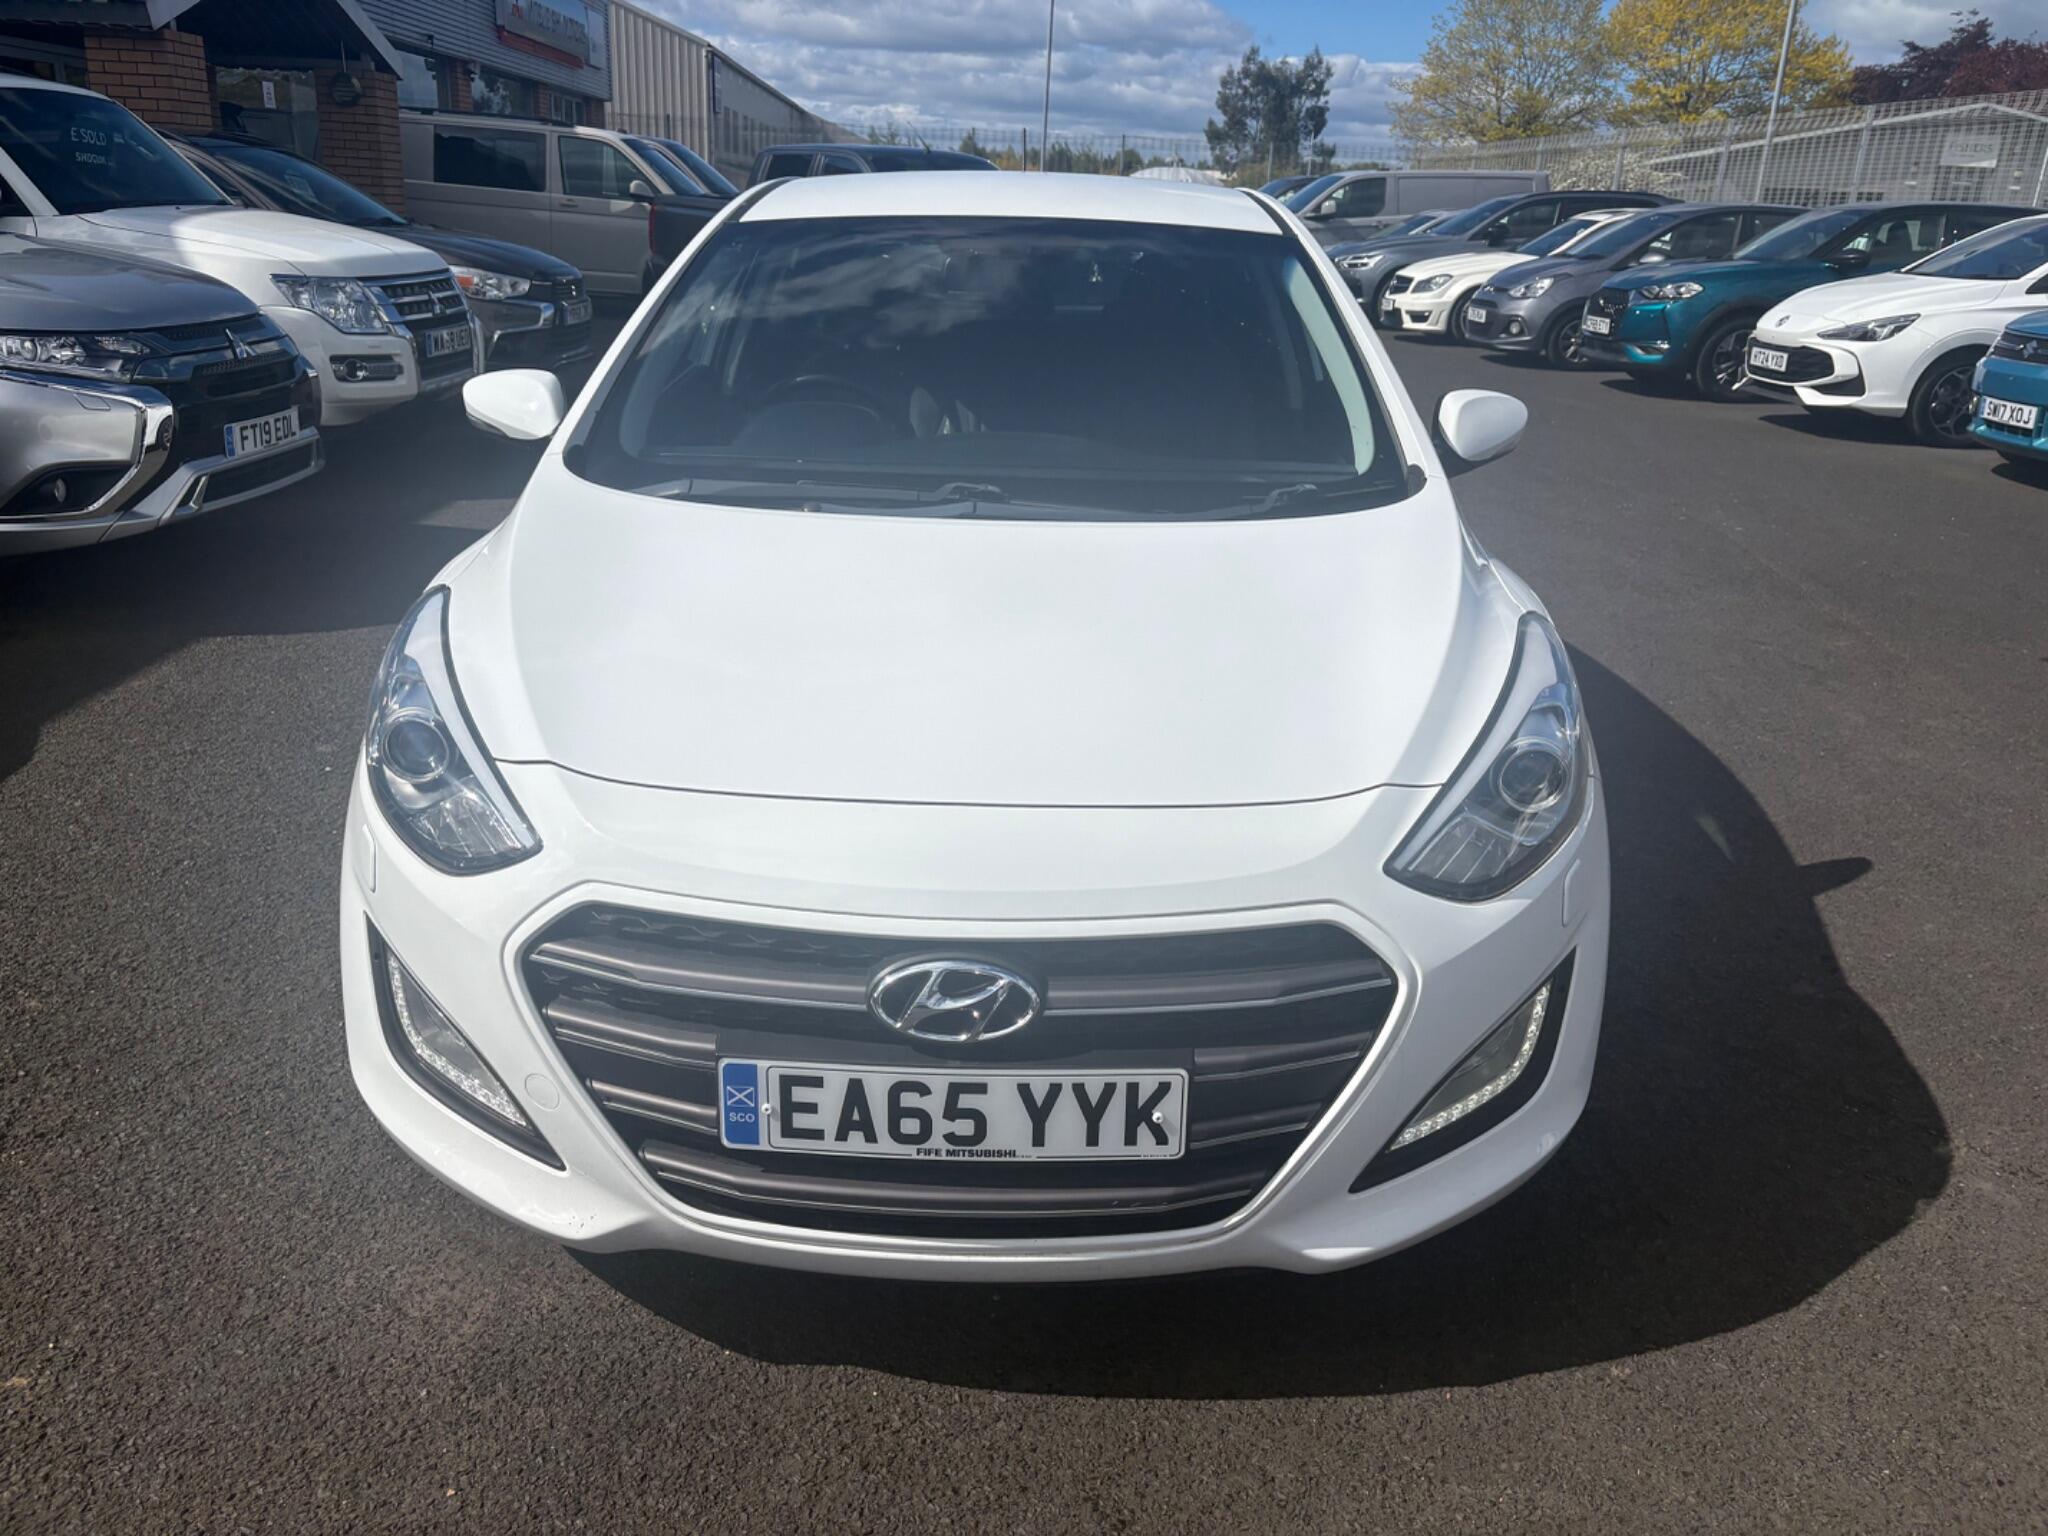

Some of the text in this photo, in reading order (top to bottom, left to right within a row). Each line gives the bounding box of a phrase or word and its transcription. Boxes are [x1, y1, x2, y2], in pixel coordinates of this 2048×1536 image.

[2008, 404, 2032, 424] XOJ
[240, 415, 296, 451] FT19 EDL
[729, 1112, 755, 1123] SCO
[778, 1074, 1171, 1147] EA65 YYK
[916, 1148, 942, 1158] FIFE
[945, 1148, 1017, 1159] MITSUBISHI
